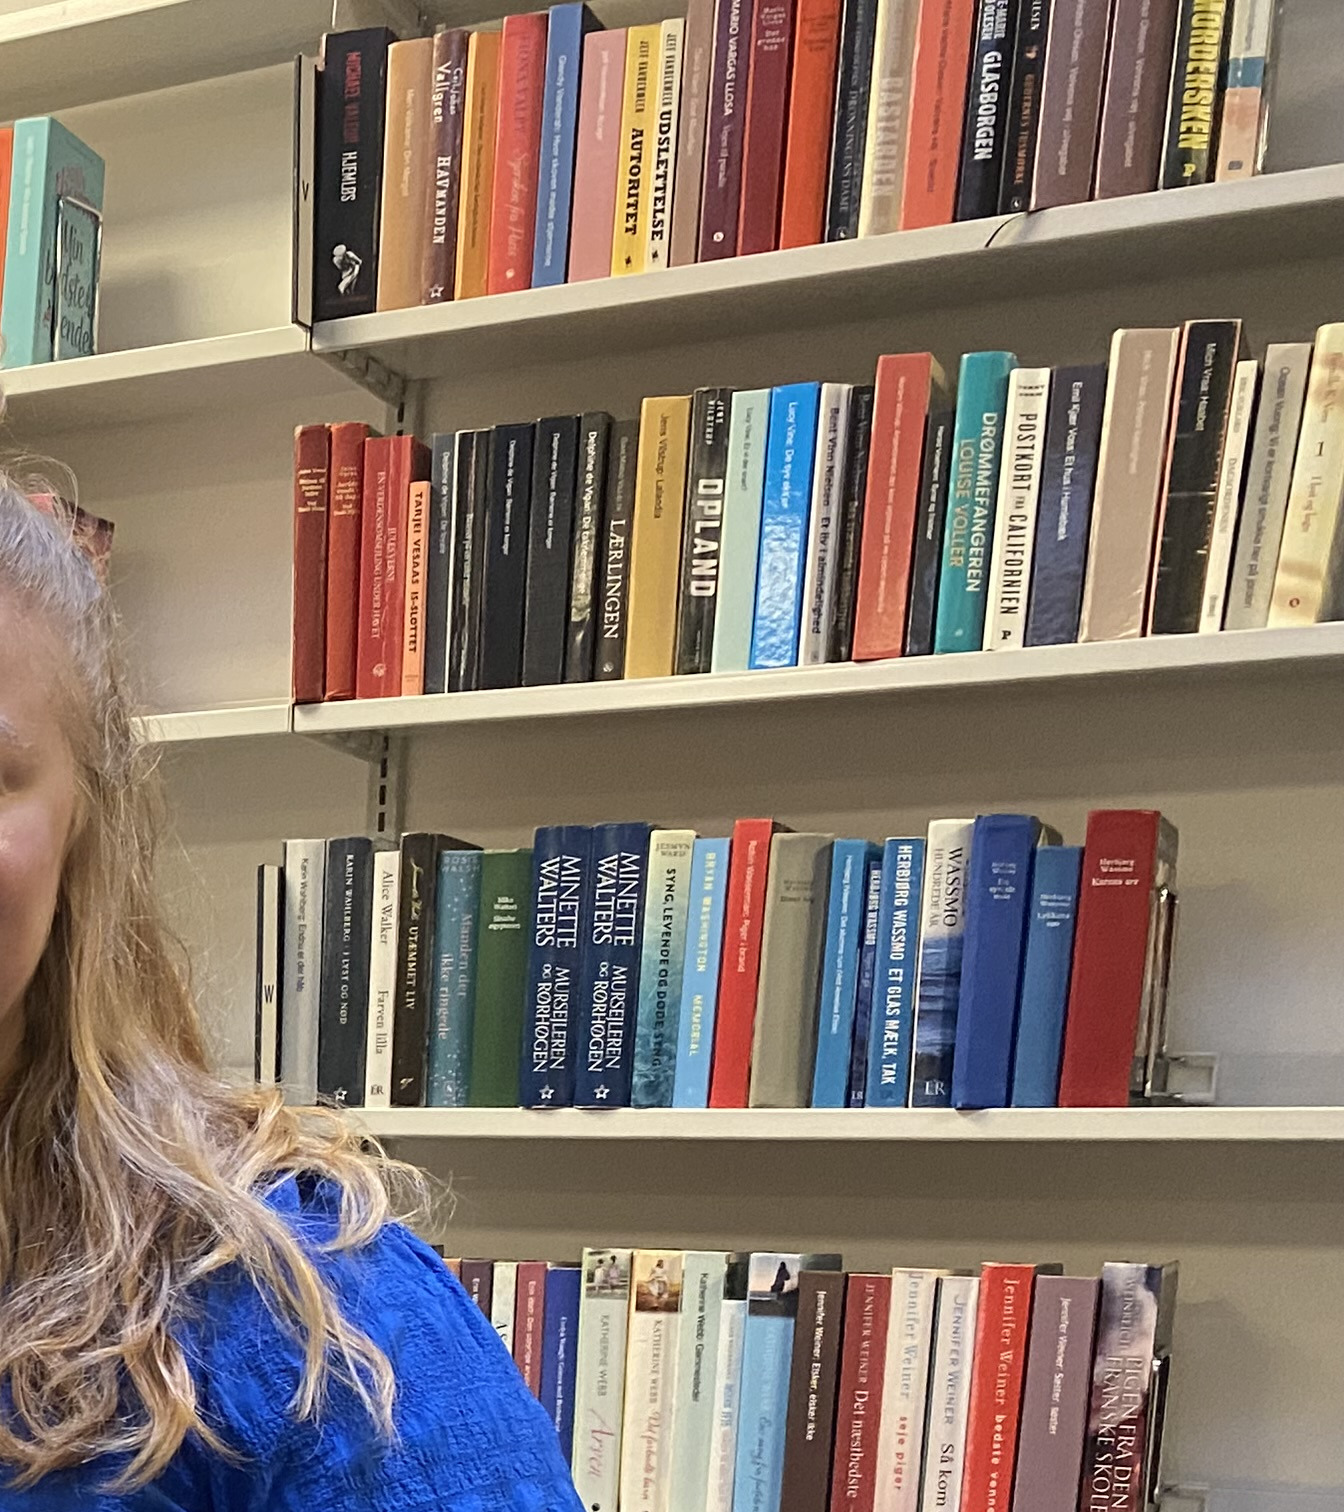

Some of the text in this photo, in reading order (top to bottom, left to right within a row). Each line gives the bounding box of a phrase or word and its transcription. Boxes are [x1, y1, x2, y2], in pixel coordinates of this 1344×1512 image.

[723, 82, 735, 116] LLOSA
[725, 37, 738, 79] VARGAS
[973, 51, 1002, 160] GLASBORGEN
[340, 151, 358, 202] HJEMLØS
[432, 156, 451, 244] HAVMANDEN
[624, 128, 644, 235] AUTORITET
[652, 110, 672, 241] UDSLETTELSE
[1011, 413, 1039, 492] POSTKORT
[949, 439, 974, 567] LOUISE VOLLER
[965, 412, 998, 592] DRØMMEFANGEREN
[408, 492, 424, 654] TARJEI VESAAS IS-SLOTTET
[603, 520, 626, 639] LÆRLINGEN
[1000, 514, 1027, 615] CALIFORNIEN
[535, 856, 561, 947] WALTERS
[556, 855, 582, 948] MINETTE
[592, 854, 618, 945] WALTERS
[613, 852, 641, 946] MINETTE
[942, 848, 964, 928] WASSMO
[375, 870, 393, 1054] Alice Walker Farven lilla
[405, 926, 419, 1010] UTÆMMET LIV
[659, 908, 674, 965] LEVENDE
[880, 845, 913, 1085] HERBJØRG WASSMO ET GLAS MÆLK, TAK
[532, 982, 554, 1072] RØRHØGEN
[549, 967, 571, 1070] MURSEJLEREN
[588, 981, 610, 1072] RØRHØGEN
[605, 965, 628, 1069] MURSEJLEREN
[948, 1295, 968, 1366] JENNIFER
[998, 1278, 1020, 1345] Jennifer
[943, 1371, 960, 1425] WEINER
[995, 1350, 1011, 1407] Weiner
[1096, 1357, 1119, 1446] FRANSKE
[939, 1443, 955, 1464] Så
[991, 1415, 1006, 1465] bedste
[1111, 1357, 1143, 1509] PIGEN FRA DEN
[935, 1470, 953, 1506] kom
